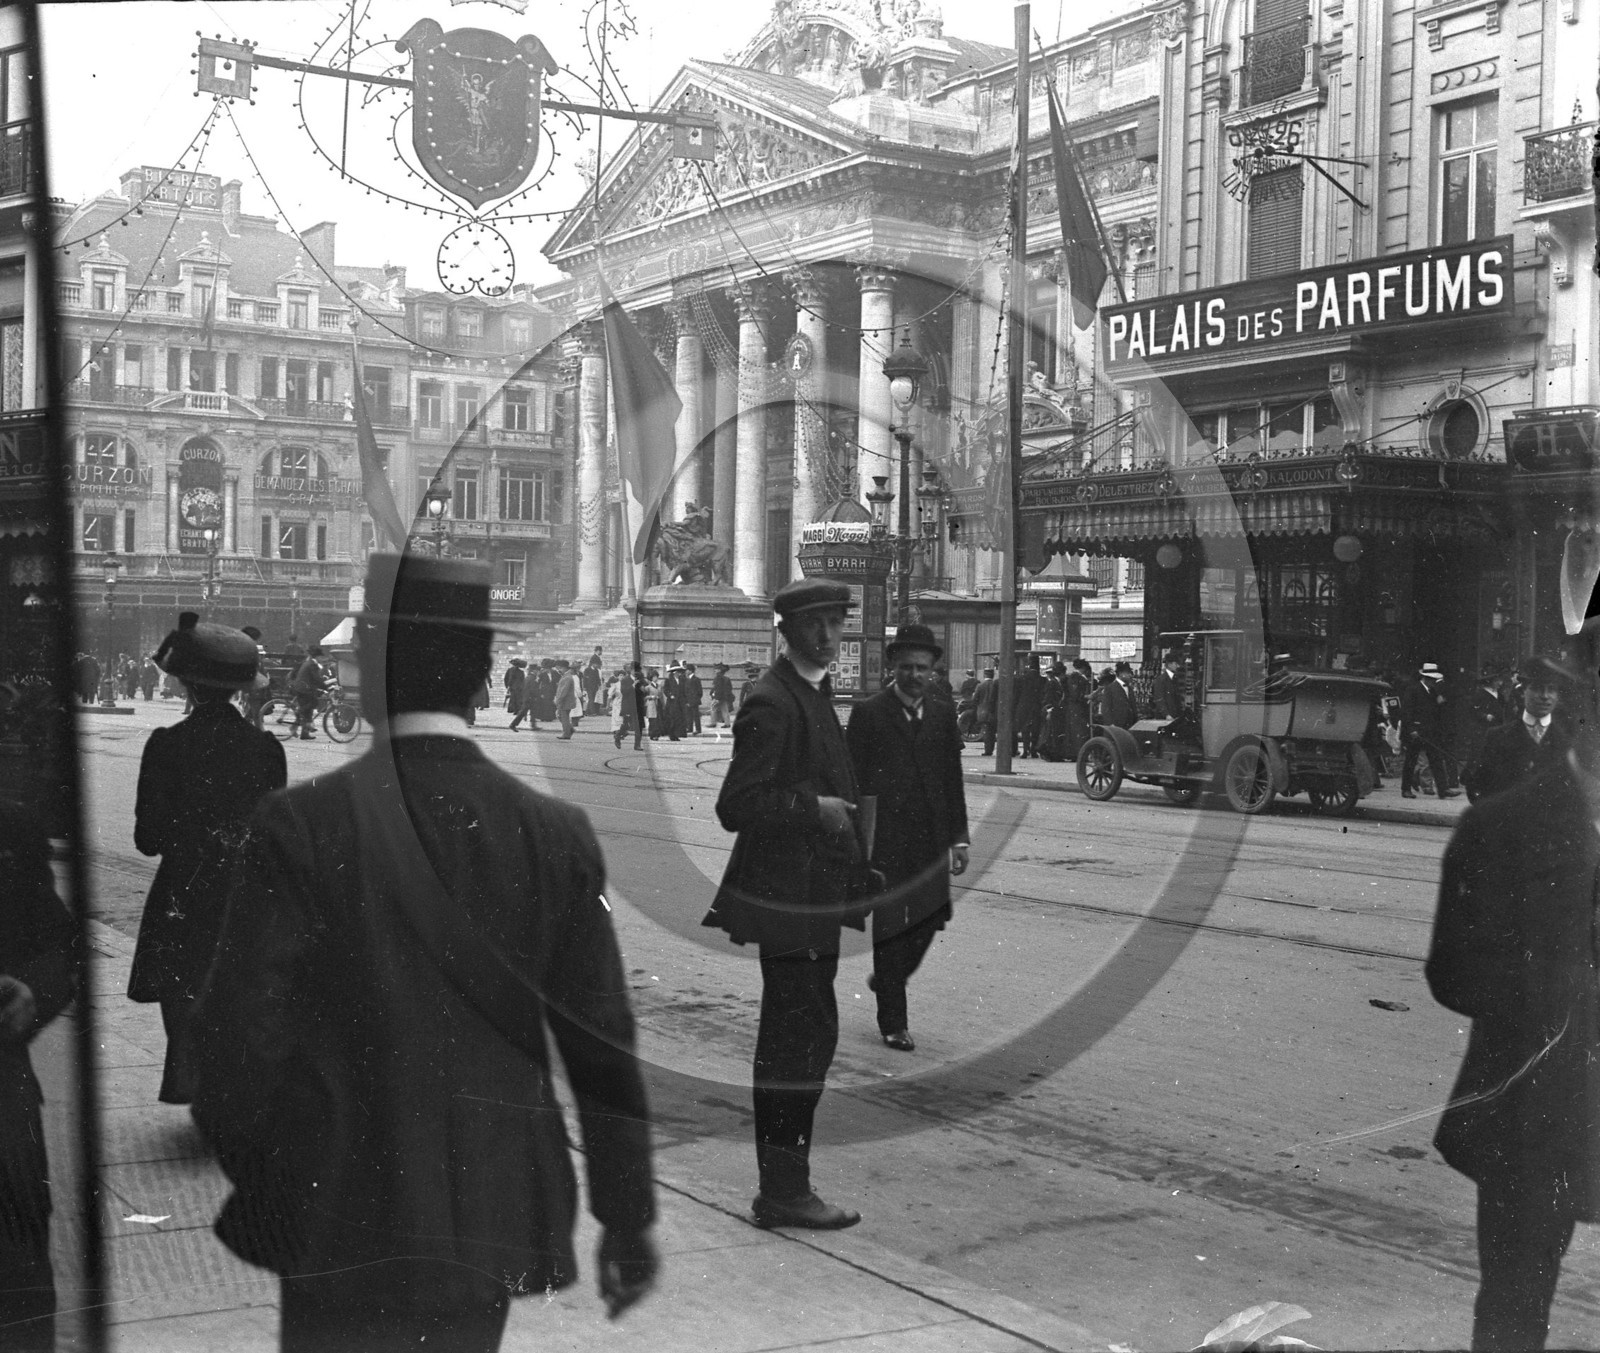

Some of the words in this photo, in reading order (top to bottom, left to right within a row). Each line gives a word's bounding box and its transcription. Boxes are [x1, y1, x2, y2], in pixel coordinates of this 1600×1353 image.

[1108, 298, 1226, 362] PALAIS
[1237, 308, 1283, 342] DES
[1295, 250, 1504, 333] PARFUMS
[183, 448, 221, 463] CURZON
[62, 463, 152, 485] CURZON
[1269, 468, 1333, 483] KALODONT
[254, 475, 304, 491] DEMANDEZ
[1099, 482, 1154, 498] DELETTREZ
[803, 530, 825, 543] MAGGI
[826, 527, 869, 543] Maggi
[827, 558, 866, 568] BYRRH
